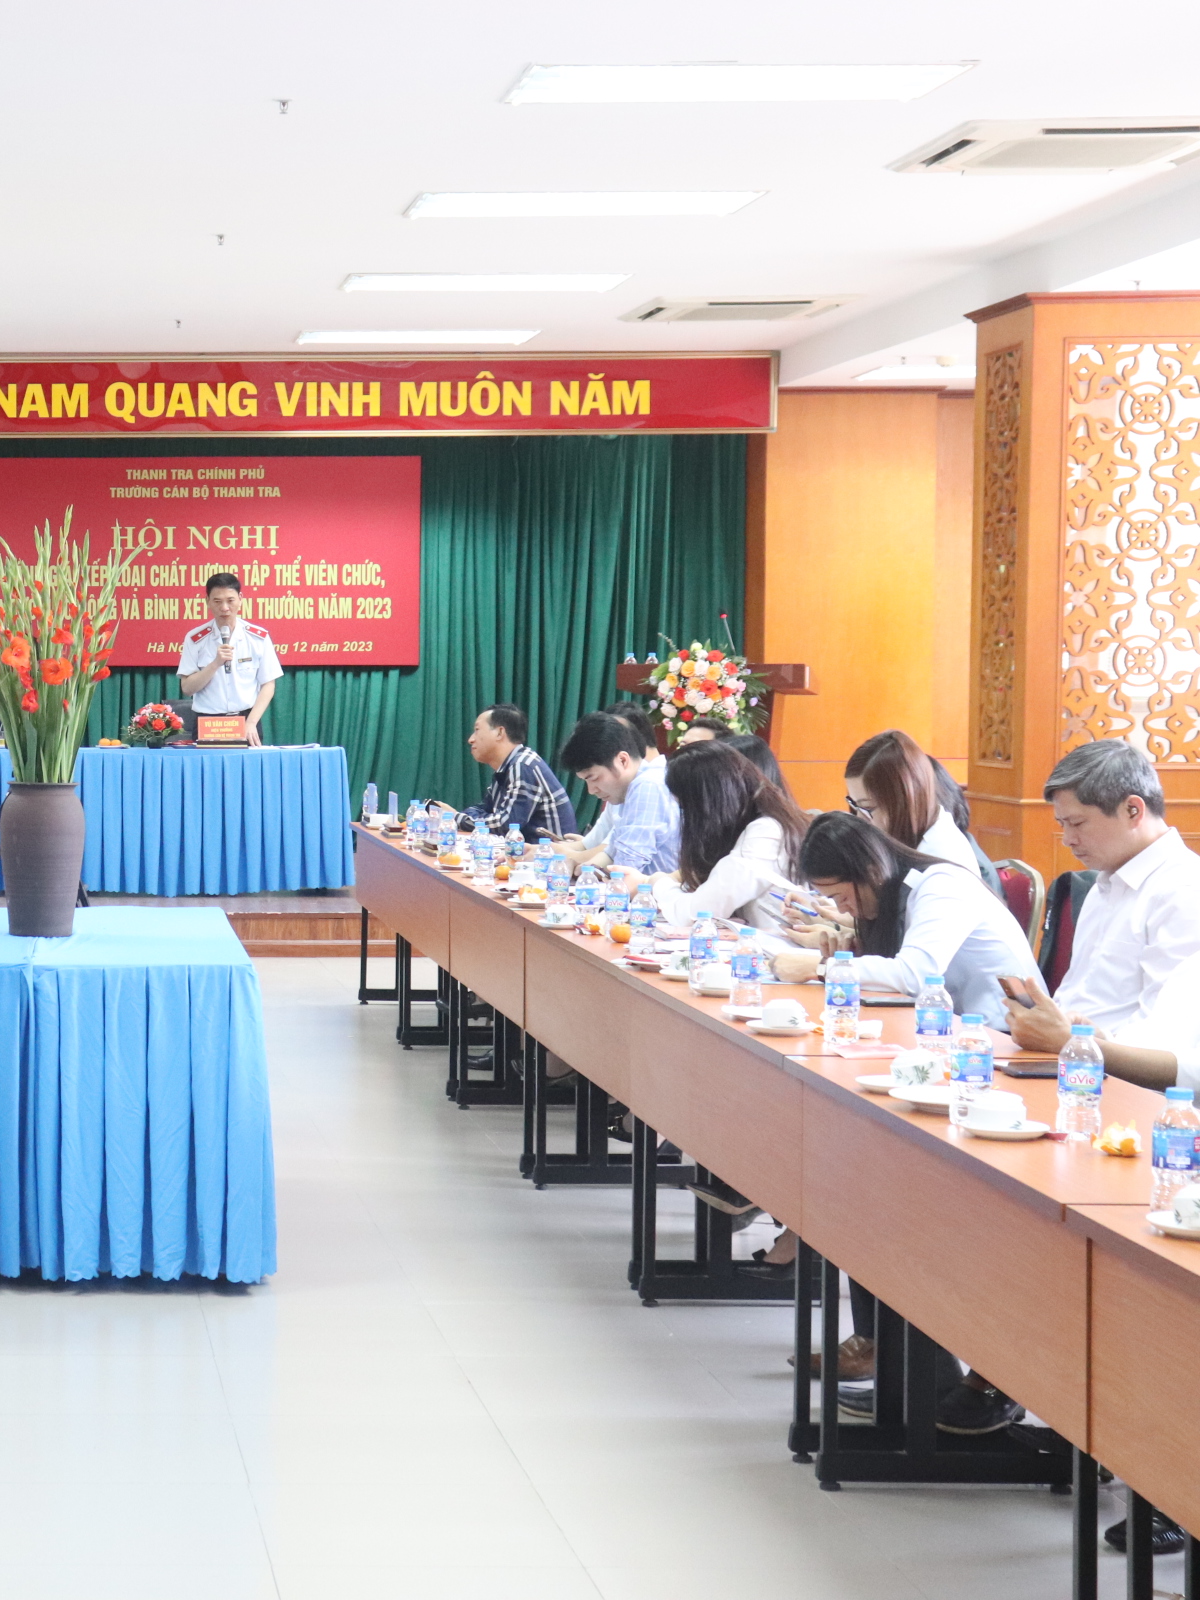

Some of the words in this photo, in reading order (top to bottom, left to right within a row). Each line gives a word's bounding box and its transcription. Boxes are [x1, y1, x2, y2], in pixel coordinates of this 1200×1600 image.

[104, 380, 258, 424] QUANG
[275, 381, 381, 417] VINH
[399, 370, 532, 417] MUÔN
[550, 372, 651, 416] NĂM
[126, 469, 167, 480] THANH
[171, 469, 194, 480] TRA
[197, 467, 236, 480] CHÍNH
[239, 465, 265, 480] PHỦ
[110, 485, 159, 498] TRƯỜNG
[163, 485, 189, 498] CÁN
[192, 485, 210, 500] BỘ
[213, 487, 254, 498] THANH
[258, 486, 281, 498] TRA
[110, 518, 177, 557] HỘI
[187, 525, 280, 556] NGHỊ
[150, 557, 188, 587] CHẤT
[243, 560, 270, 591] TẬP
[274, 556, 301, 586] THỂ
[304, 560, 338, 586] VIÊN
[342, 559, 386, 588] CHỨC,
[121, 593, 140, 620] VÀ
[144, 593, 179, 620] BÌNH
[183, 593, 208, 620] XÉT
[256, 590, 314, 619] THƯỞNG
[318, 593, 352, 619] NĂM
[356, 597, 392, 619] 2023
[147, 642, 165, 653] Hà
[293, 641, 308, 652] 12
[310, 641, 339, 652] năm
[342, 641, 373, 652] 2023
[1066, 1073, 1096, 1085] laVie
